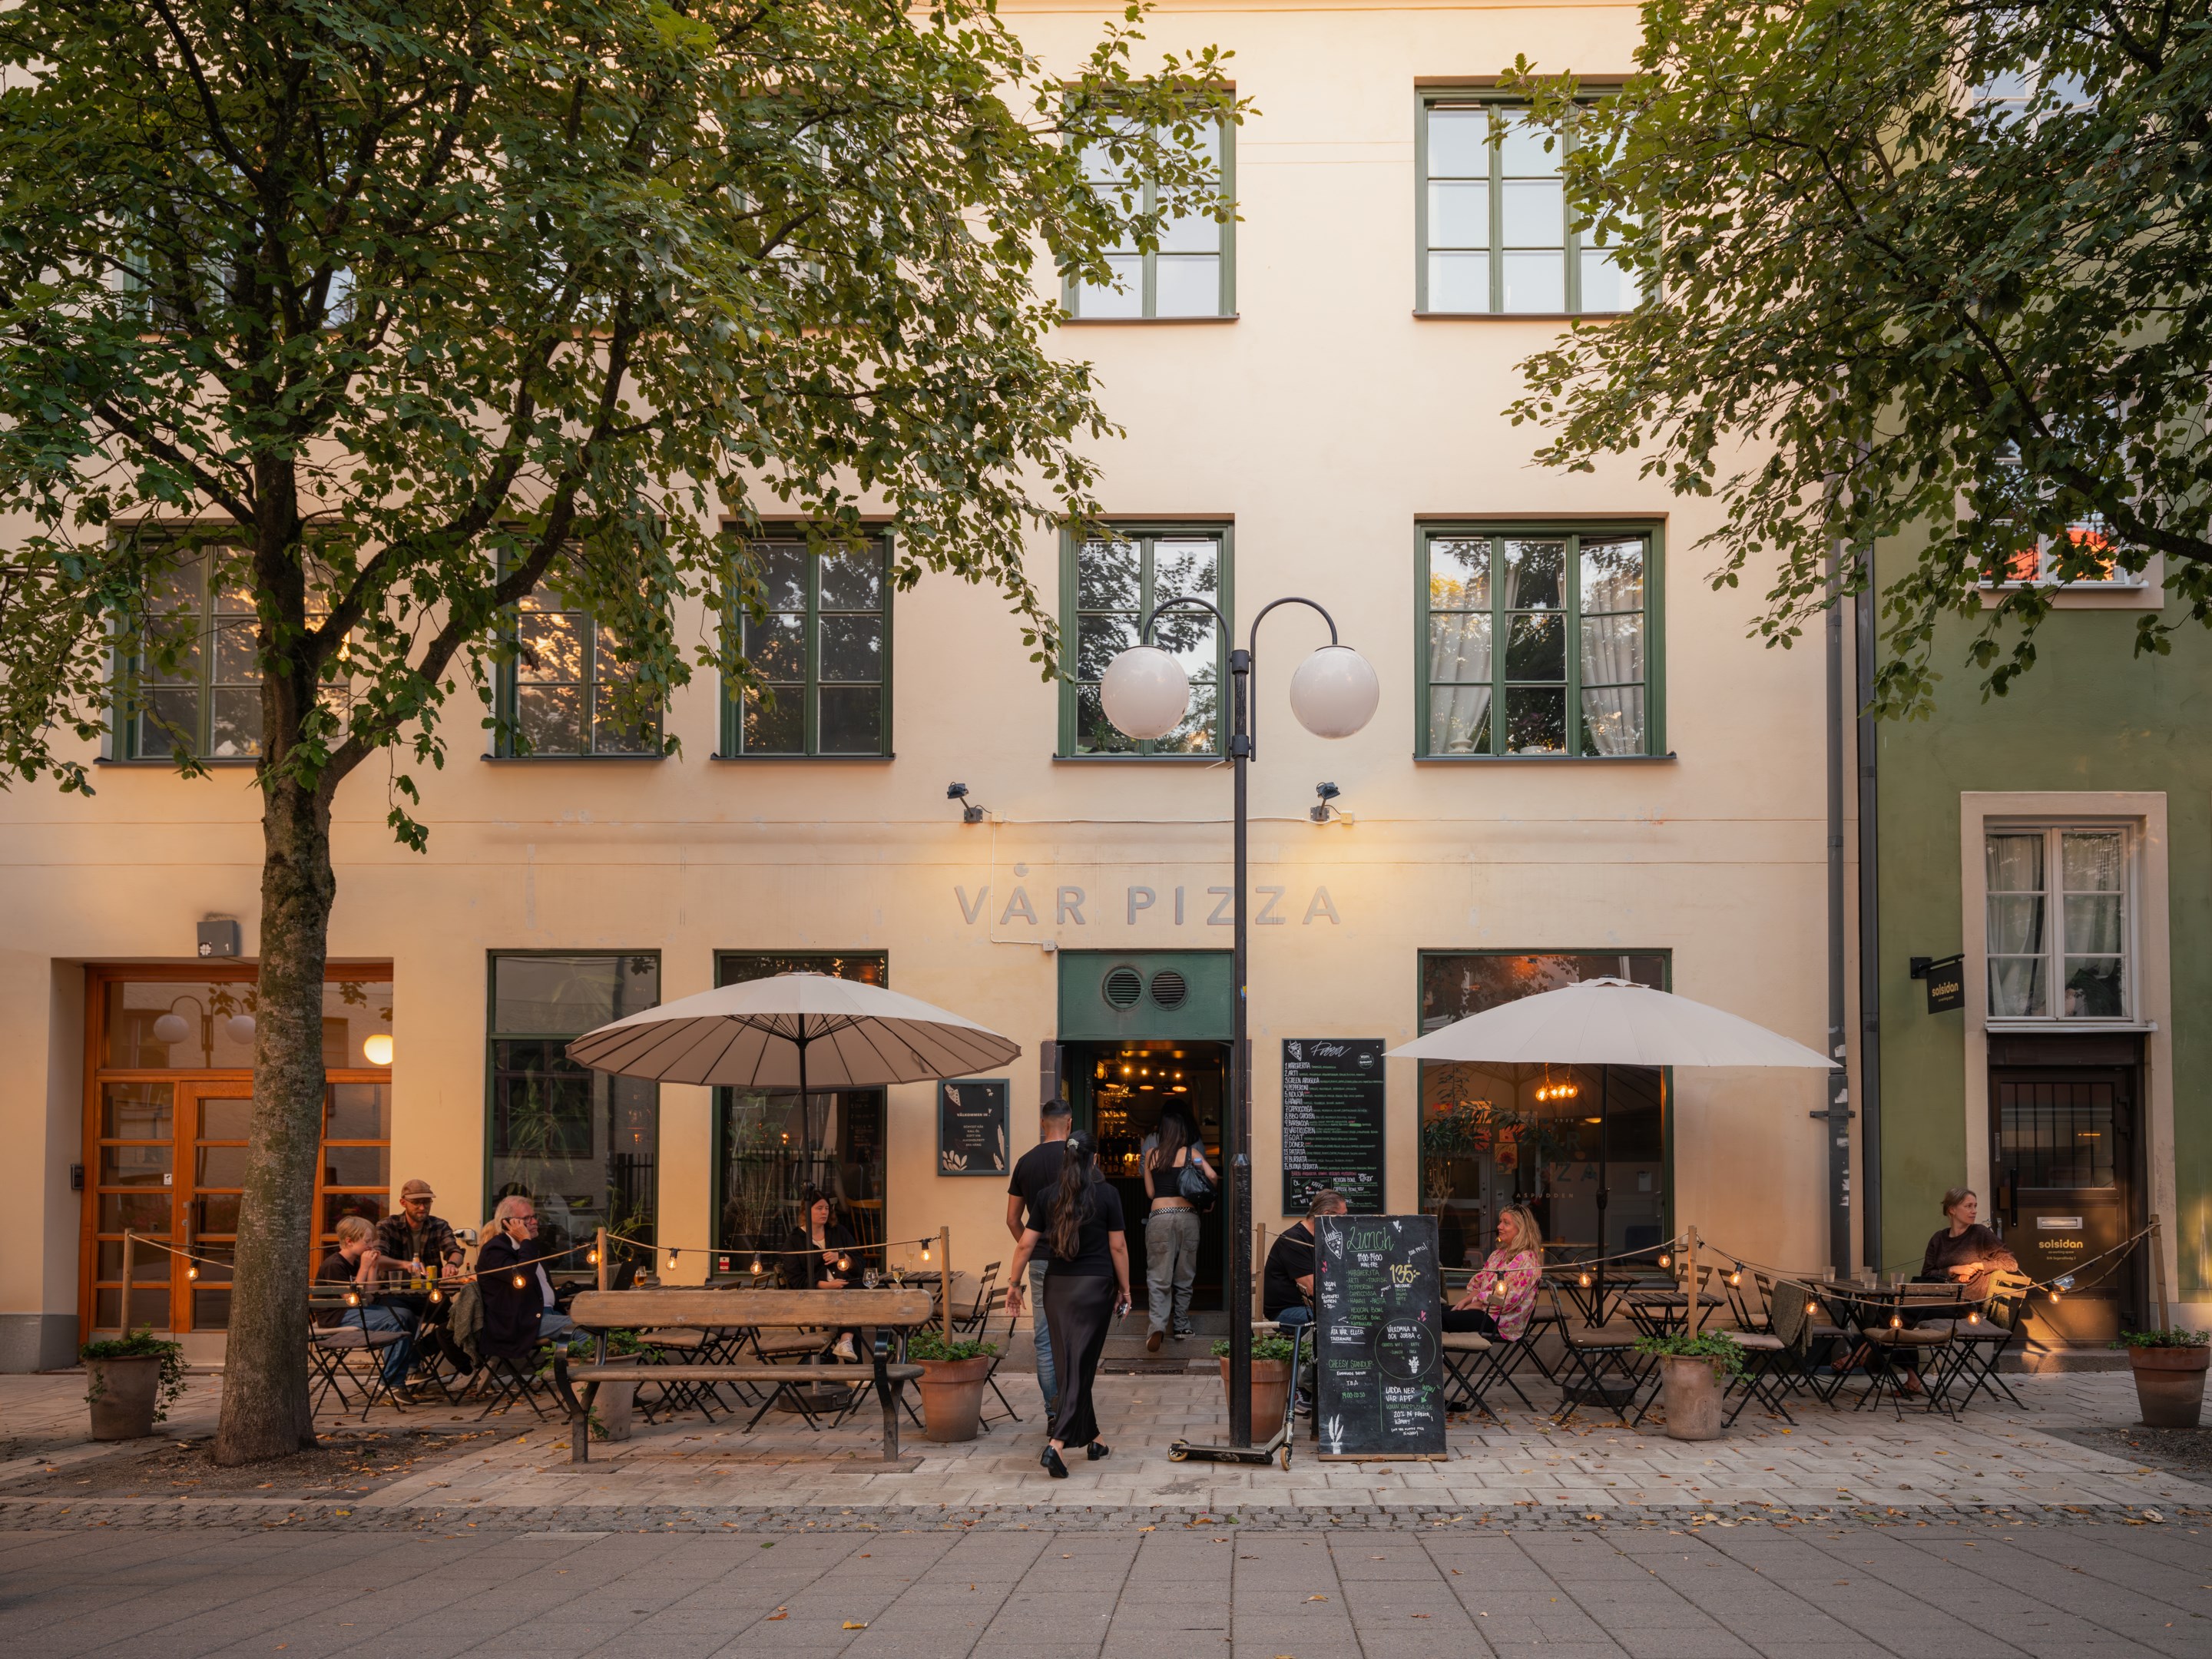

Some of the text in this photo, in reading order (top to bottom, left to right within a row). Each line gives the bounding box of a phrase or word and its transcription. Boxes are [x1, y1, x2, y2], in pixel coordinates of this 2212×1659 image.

[954, 861, 1342, 926] VÅR PIZZA
[224, 943, 230, 952] 1
[1932, 981, 1959, 998] solsidan
[1311, 1181, 1324, 1190] KAFFE
[2038, 1239, 2084, 1249] solsidan
[1329, 1359, 1373, 1369] CHEESY STANDUP
[1386, 1386, 1416, 1395] LADDA NER
[1399, 1394, 1414, 1402] APP
